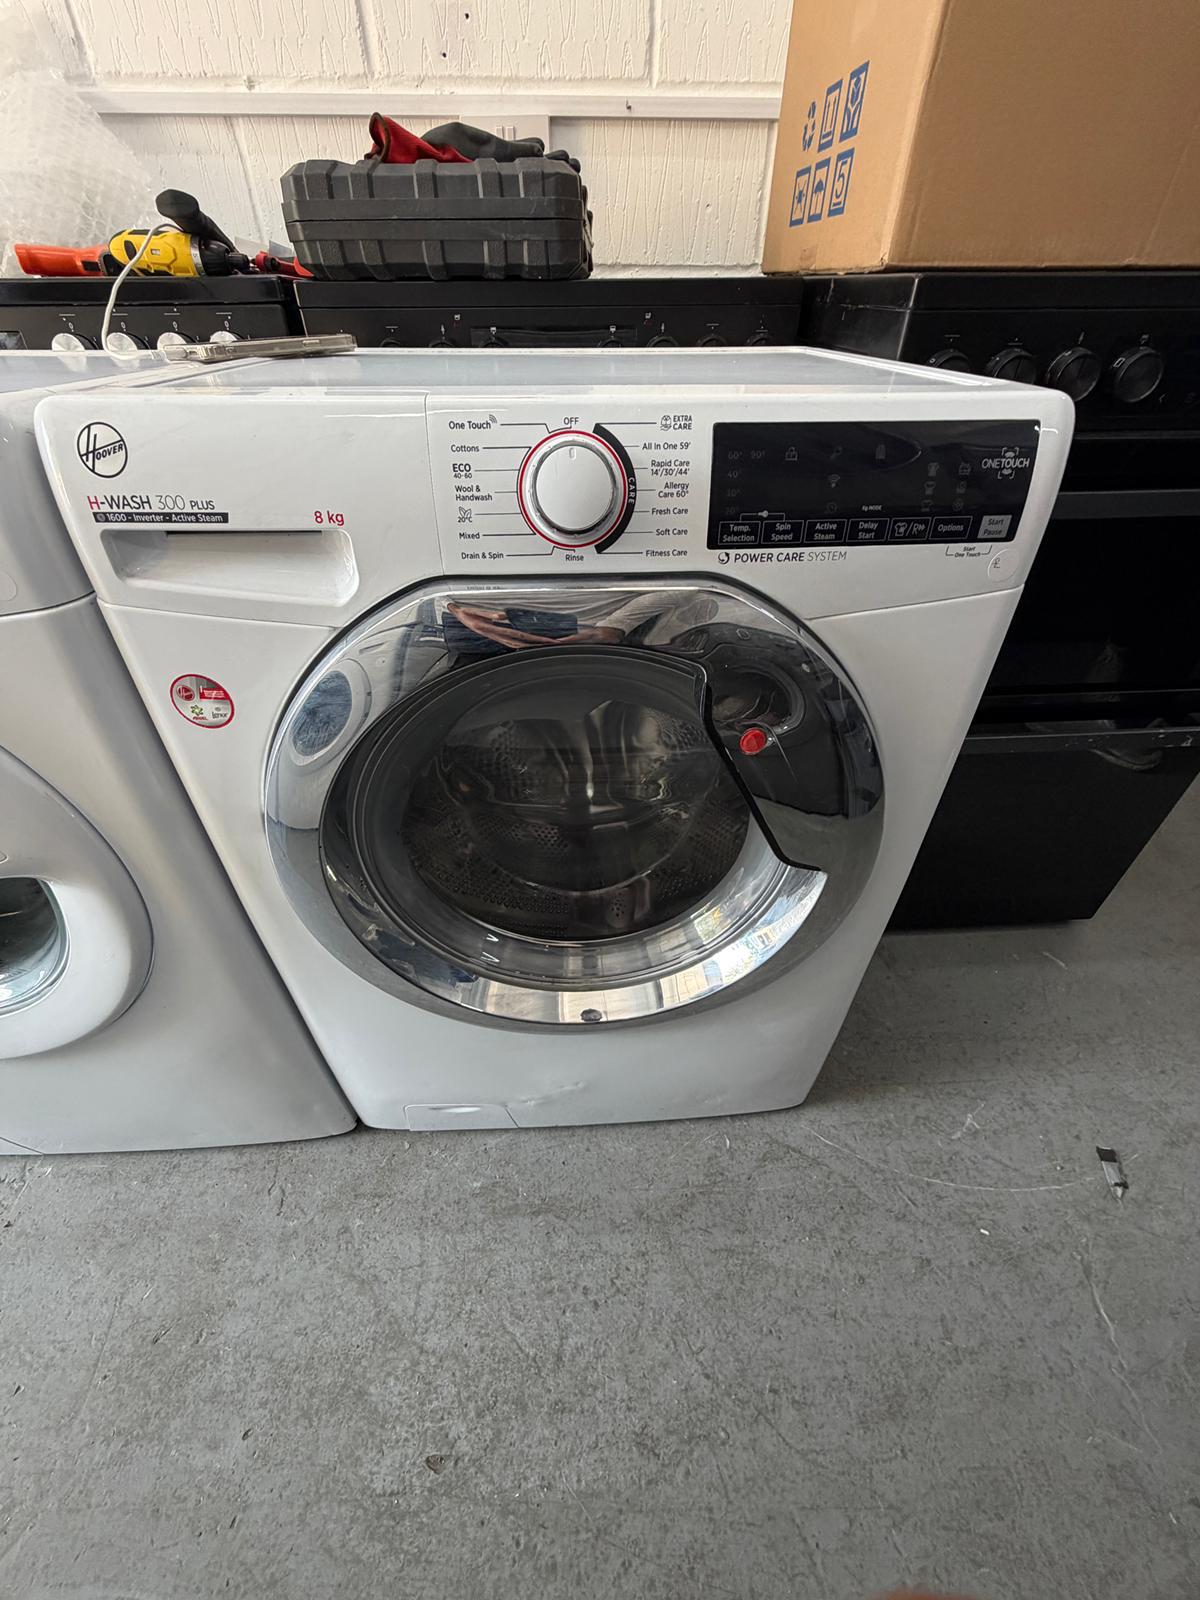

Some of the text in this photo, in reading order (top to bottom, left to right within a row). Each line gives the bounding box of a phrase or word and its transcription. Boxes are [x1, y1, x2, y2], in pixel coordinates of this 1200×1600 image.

[448, 420, 492, 430] One Touch
[563, 417, 579, 425] OFF
[450, 444, 480, 453] Cottons
[642, 442, 653, 450] All
[654, 442, 661, 450] In
[663, 442, 678, 450] One
[651, 459, 690, 468] Rapid Care
[982, 458, 1030, 469] ONETOUCH
[452, 464, 471, 473] ECO
[455, 485, 474, 493] Wool
[628, 477, 636, 504] CARE
[664, 482, 690, 491] Allergy
[455, 493, 493, 501] Handwash
[658, 490, 674, 498] Care
[87, 495, 215, 511] H-WASH 300 PLUS
[133, 513, 164, 522] Inverter
[172, 513, 196, 522] Active
[198, 513, 224, 522] Steam
[313, 510, 345, 527] 8 kg
[815, 522, 837, 530] Active
[858, 521, 879, 531] Delay
[988, 518, 1004, 526] Start
[729, 524, 751, 532] Temp.
[775, 522, 791, 531] Spin
[937, 524, 964, 532] Options
[459, 532, 480, 540] Mixed
[655, 528, 688, 536] Soft Care
[813, 532, 836, 540] Steam
[857, 532, 875, 540] Start
[983, 528, 1002, 536] Pause
[722, 534, 755, 543] Selection
[771, 532, 793, 542] Speed
[461, 552, 480, 560] Drain
[488, 552, 504, 561] Spin
[645, 549, 688, 557] Fitness Care
[734, 551, 847, 563] POWER CARE SYSTEM
[565, 554, 584, 562] Rinse
